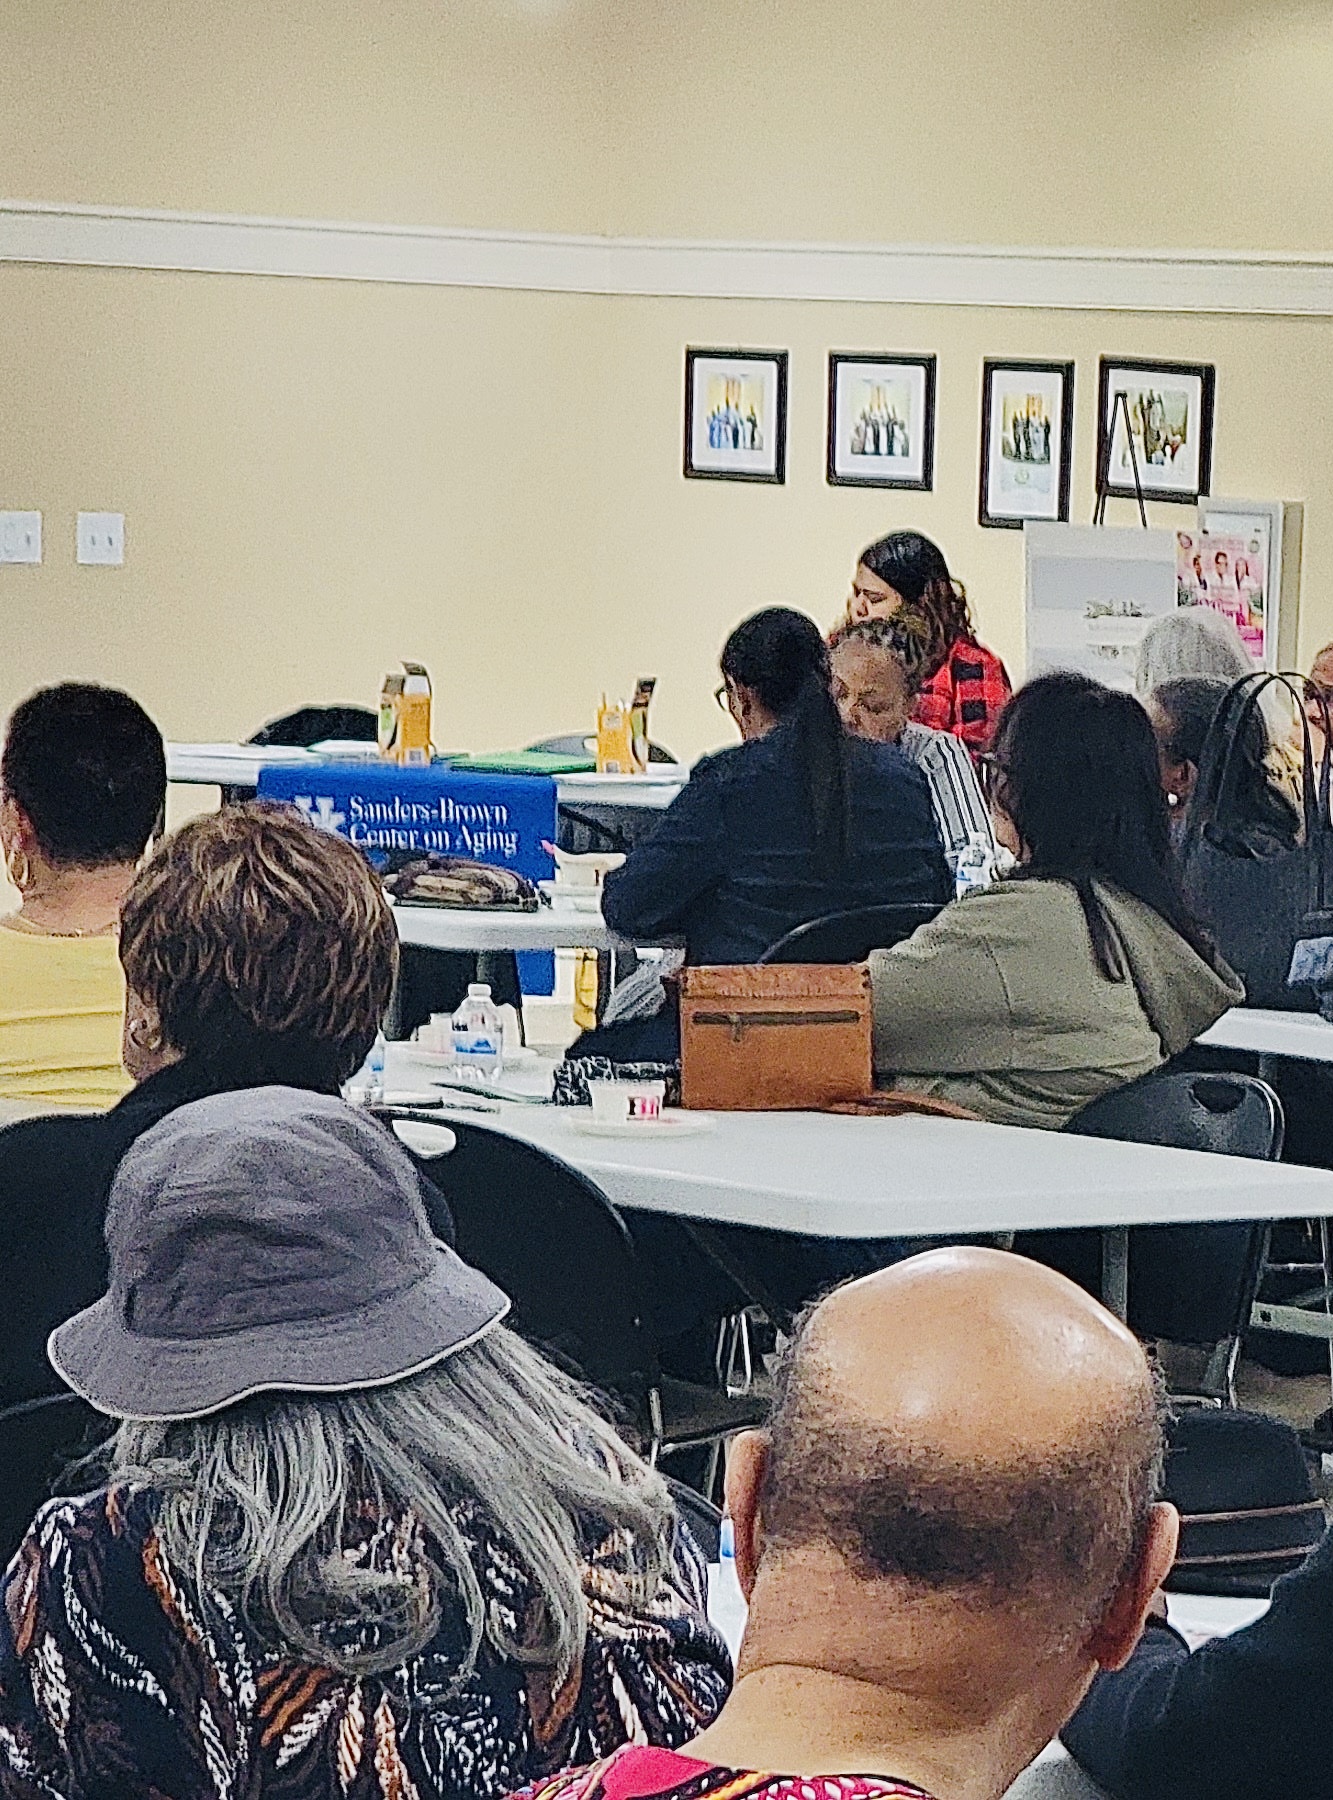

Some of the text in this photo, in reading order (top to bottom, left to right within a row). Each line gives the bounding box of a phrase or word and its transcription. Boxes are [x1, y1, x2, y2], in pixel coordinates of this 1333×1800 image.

[349, 796, 508, 825] Sanders-Brown
[350, 823, 519, 860] Center on Aging
